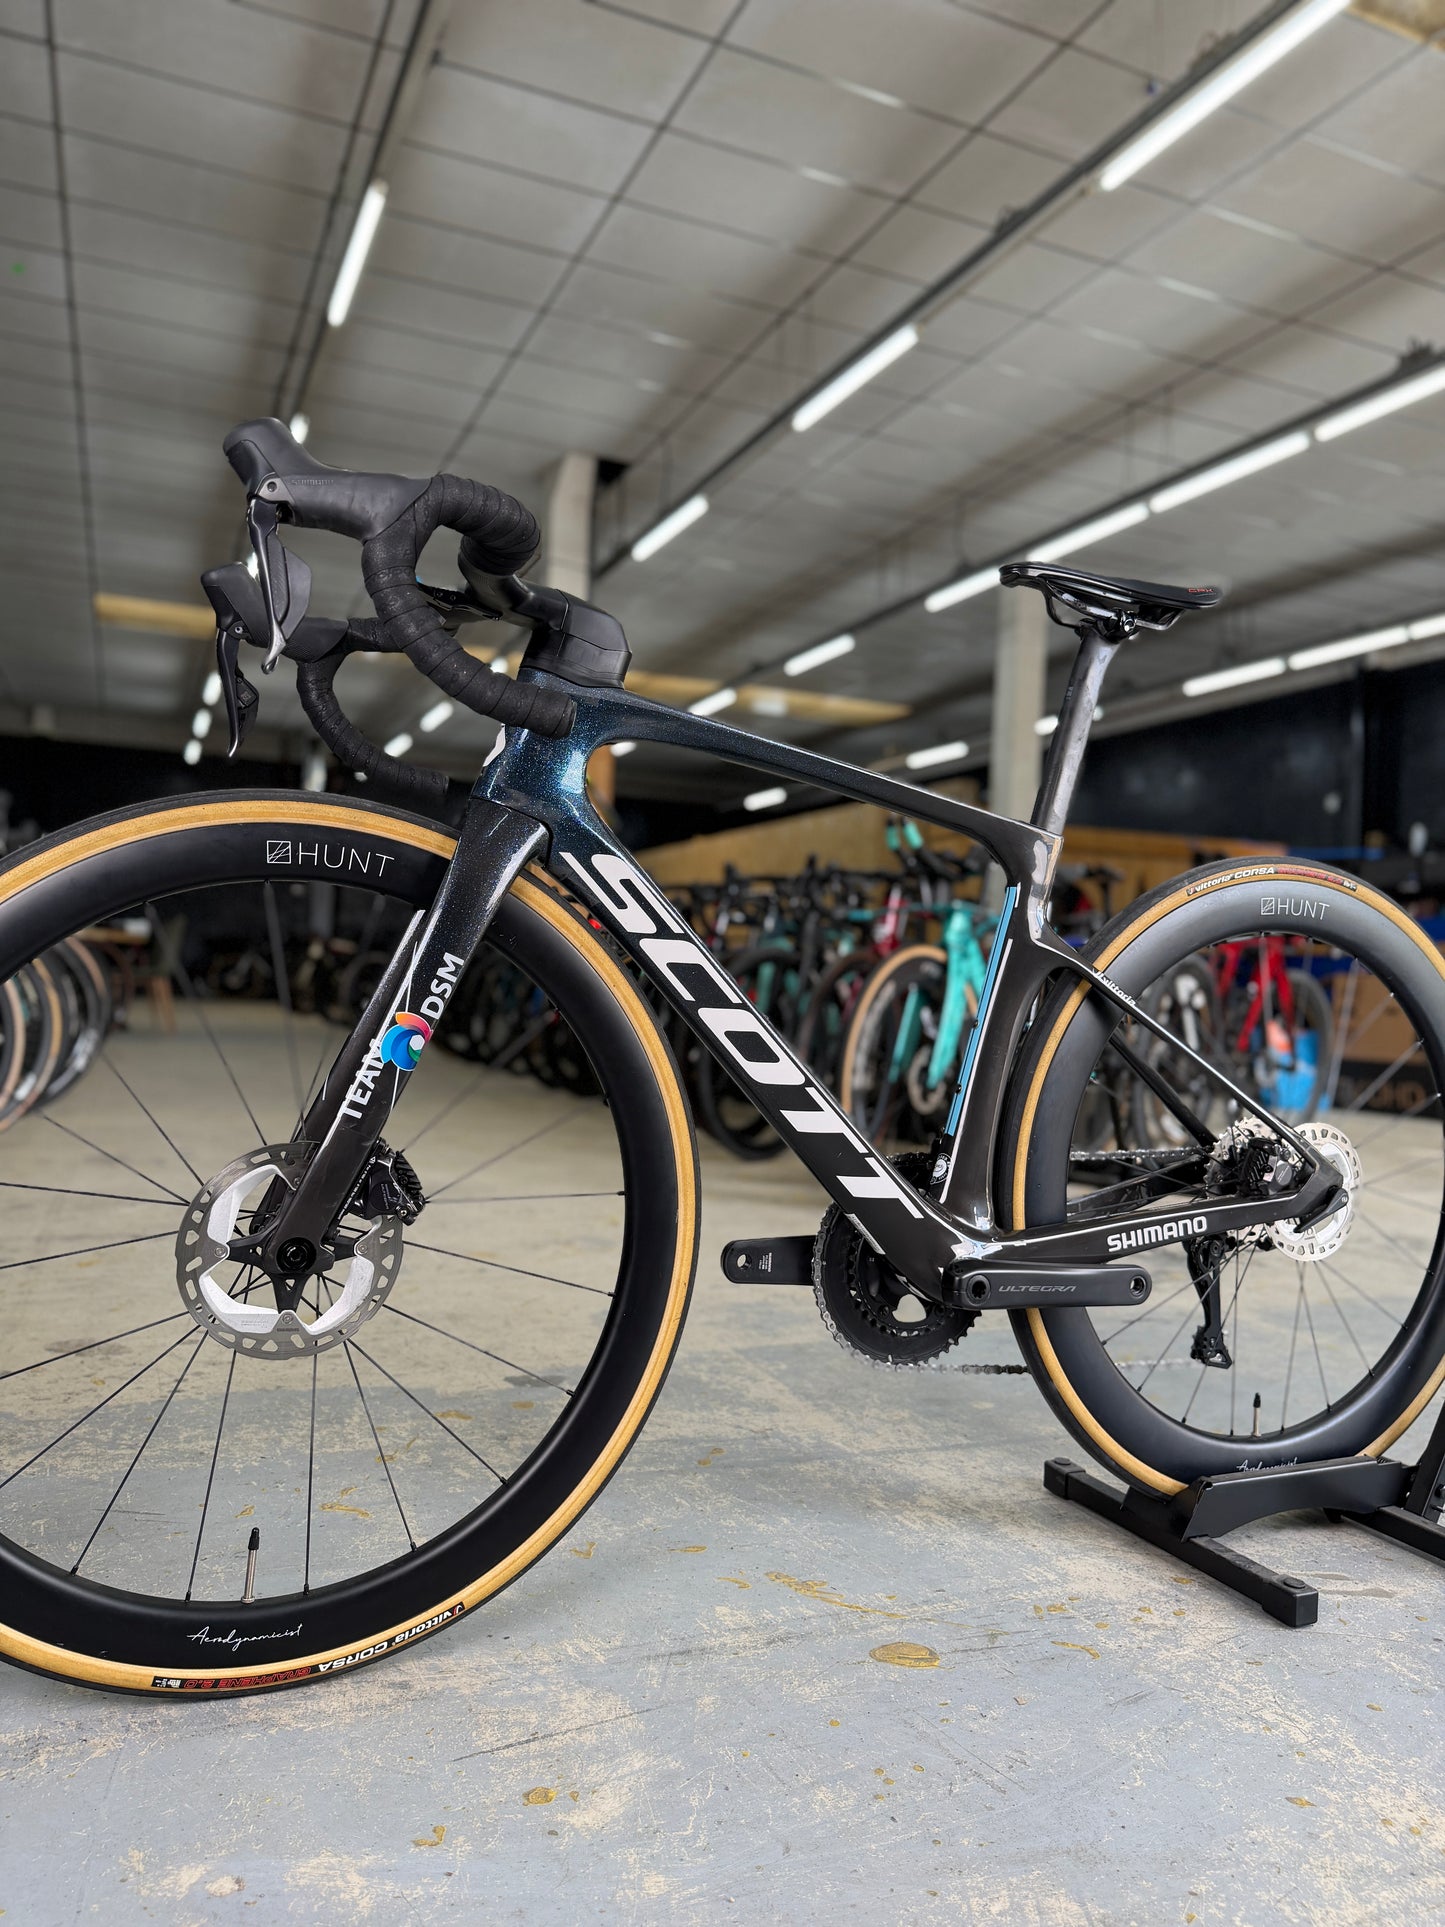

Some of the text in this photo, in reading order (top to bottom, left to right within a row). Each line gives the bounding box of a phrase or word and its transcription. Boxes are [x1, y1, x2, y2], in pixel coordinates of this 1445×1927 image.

[298, 842, 395, 877] HUNT
[1234, 867, 1275, 879] CORSA
[1278, 898, 1330, 920] HUNT
[420, 952, 465, 1020] DSM
[559, 852, 924, 1218] SCOTT
[1107, 1216, 1208, 1252] SHIMANO
[998, 1284, 1077, 1293] ULTEGRA
[184, 1611, 453, 1688] vittoria CORSA GRAPHENE 2.0
[187, 1623, 303, 1652] Aerodynamicist
